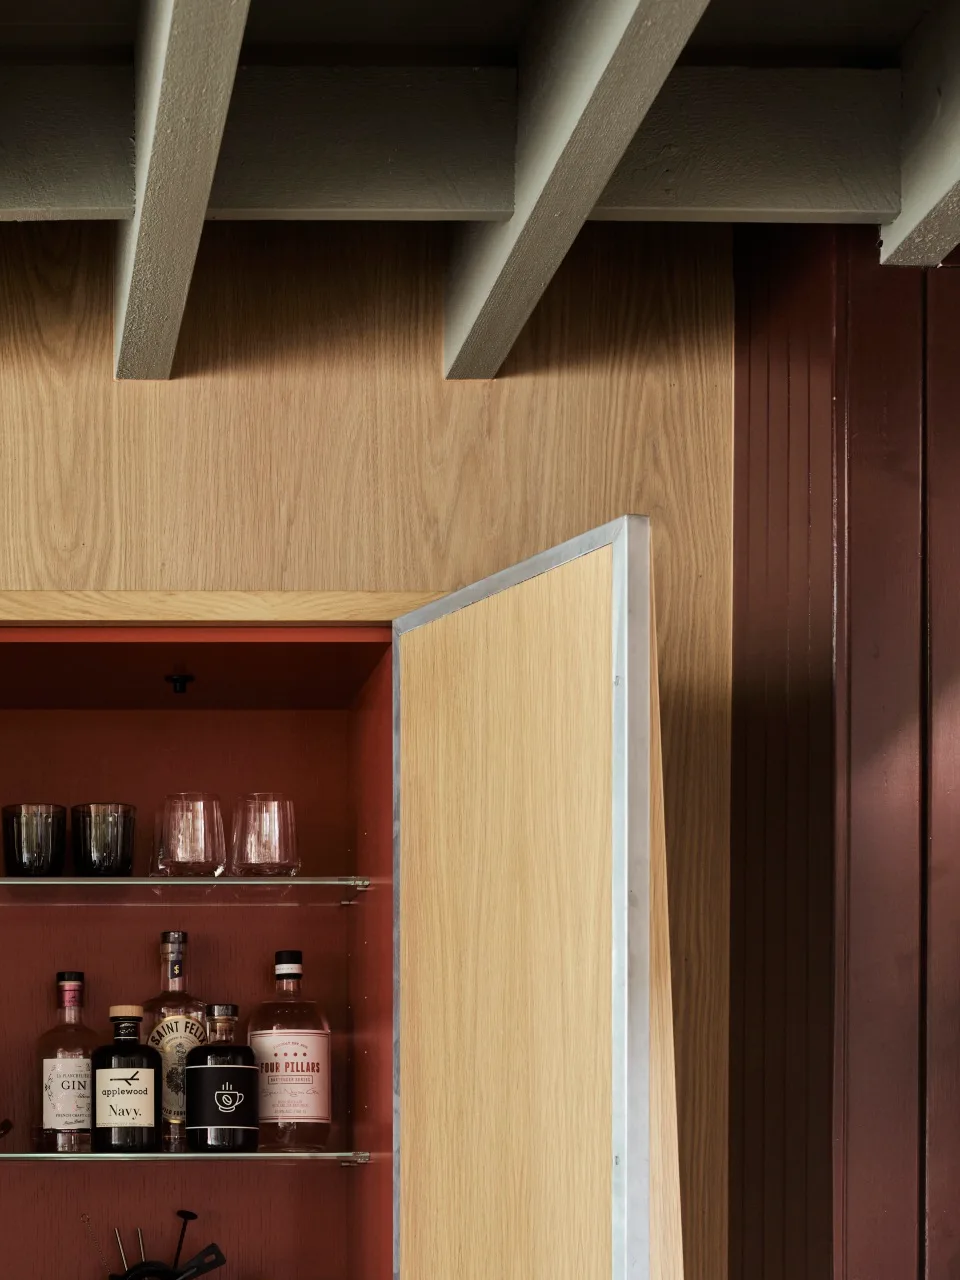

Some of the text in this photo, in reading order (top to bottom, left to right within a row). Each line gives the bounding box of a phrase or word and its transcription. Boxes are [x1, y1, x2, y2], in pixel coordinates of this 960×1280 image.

[150, 1020, 180, 1046] SAINT
[184, 1020, 209, 1045] FELIX
[260, 1061, 320, 1074] FOUR PILLARS
[61, 1080, 87, 1091] GIN
[101, 1087, 148, 1098] applewood
